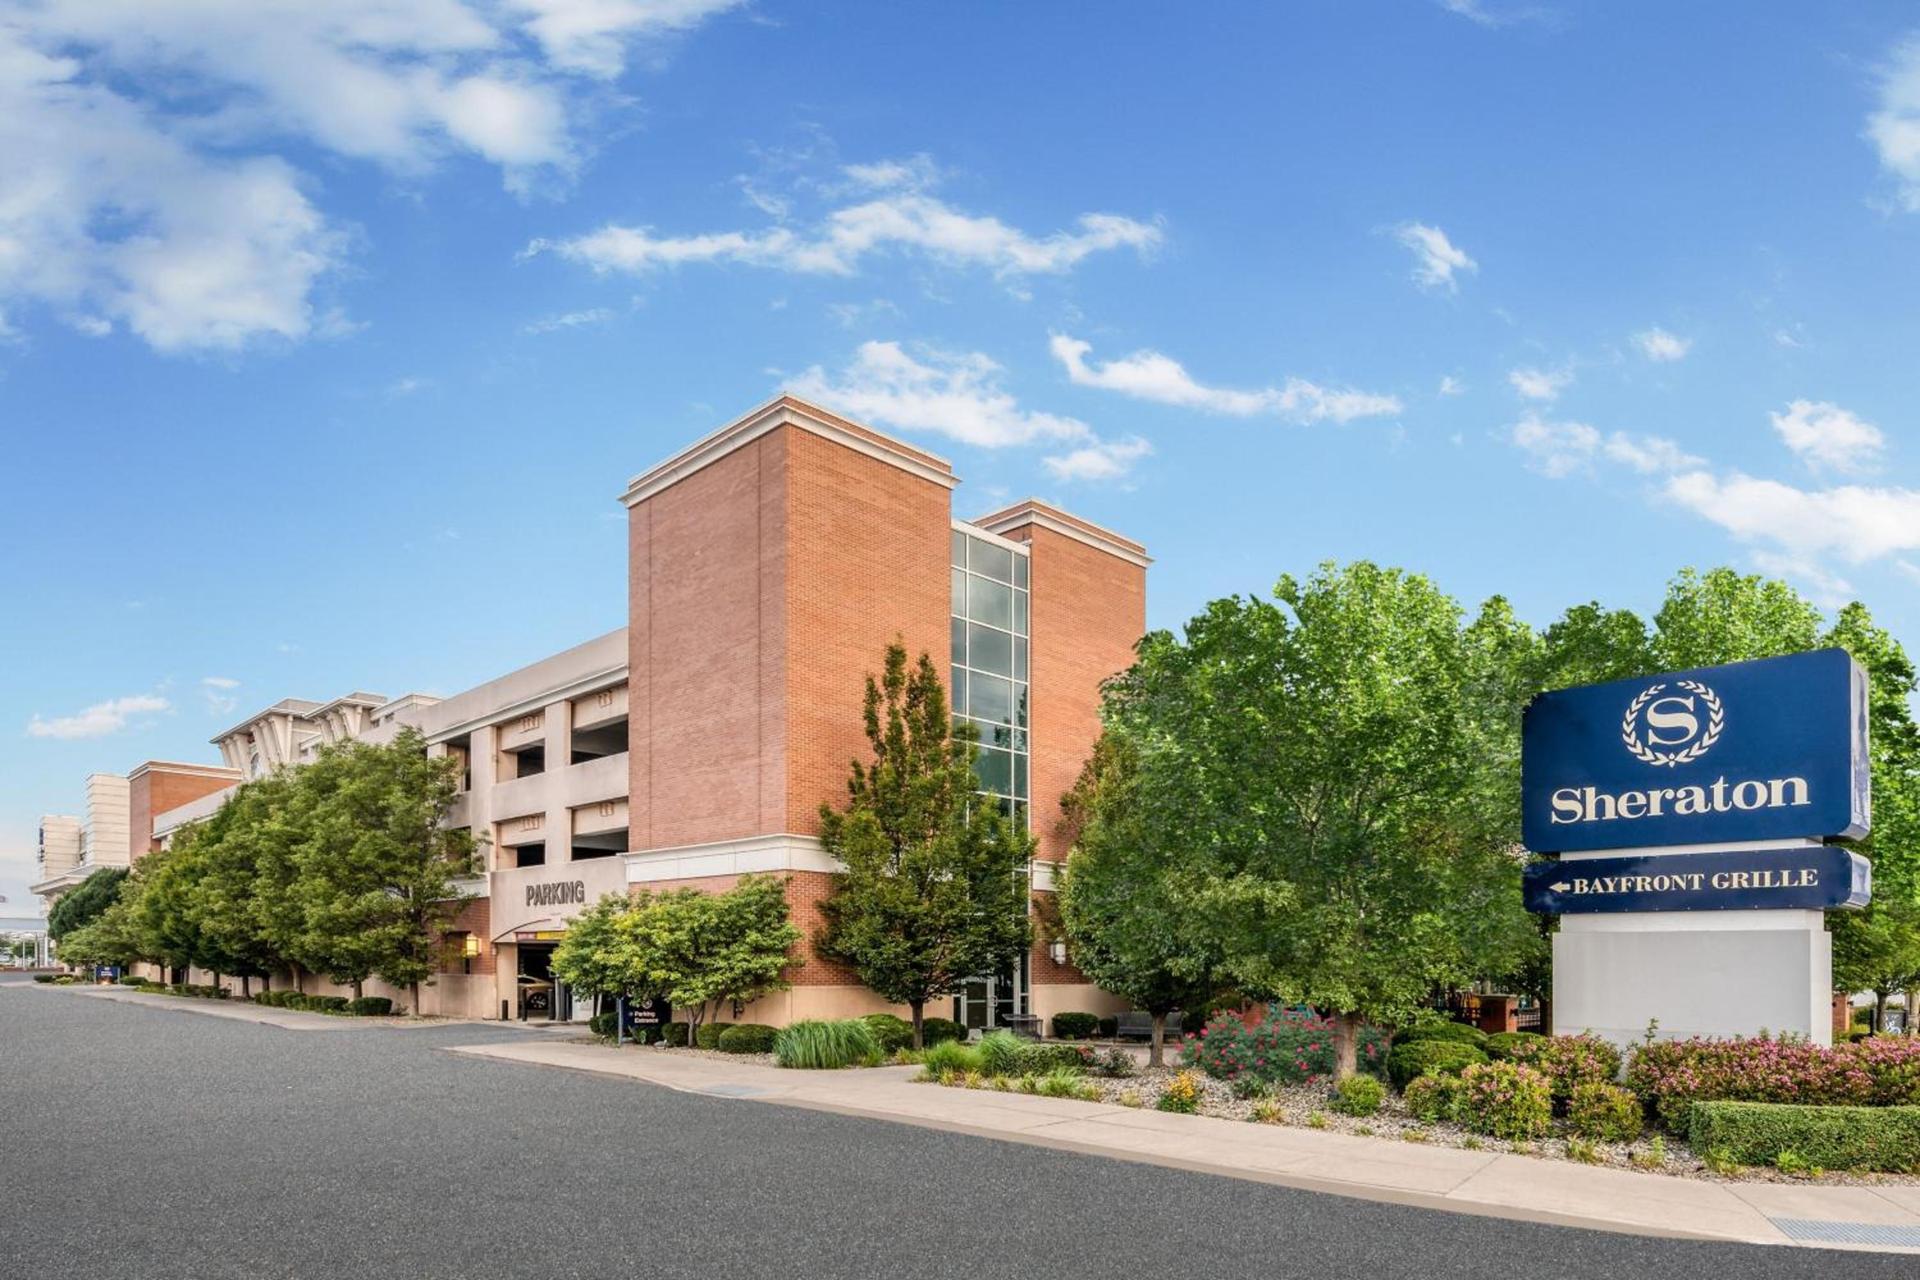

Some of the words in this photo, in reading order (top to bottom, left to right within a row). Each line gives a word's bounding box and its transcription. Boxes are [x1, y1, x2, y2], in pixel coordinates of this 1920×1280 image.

[1646, 697, 1699, 746] S
[1551, 775, 1812, 825] Sheraton
[526, 880, 585, 907] PARKING
[1573, 873, 1704, 895] BAYFRONT
[1711, 868, 1819, 890] GRILLE
